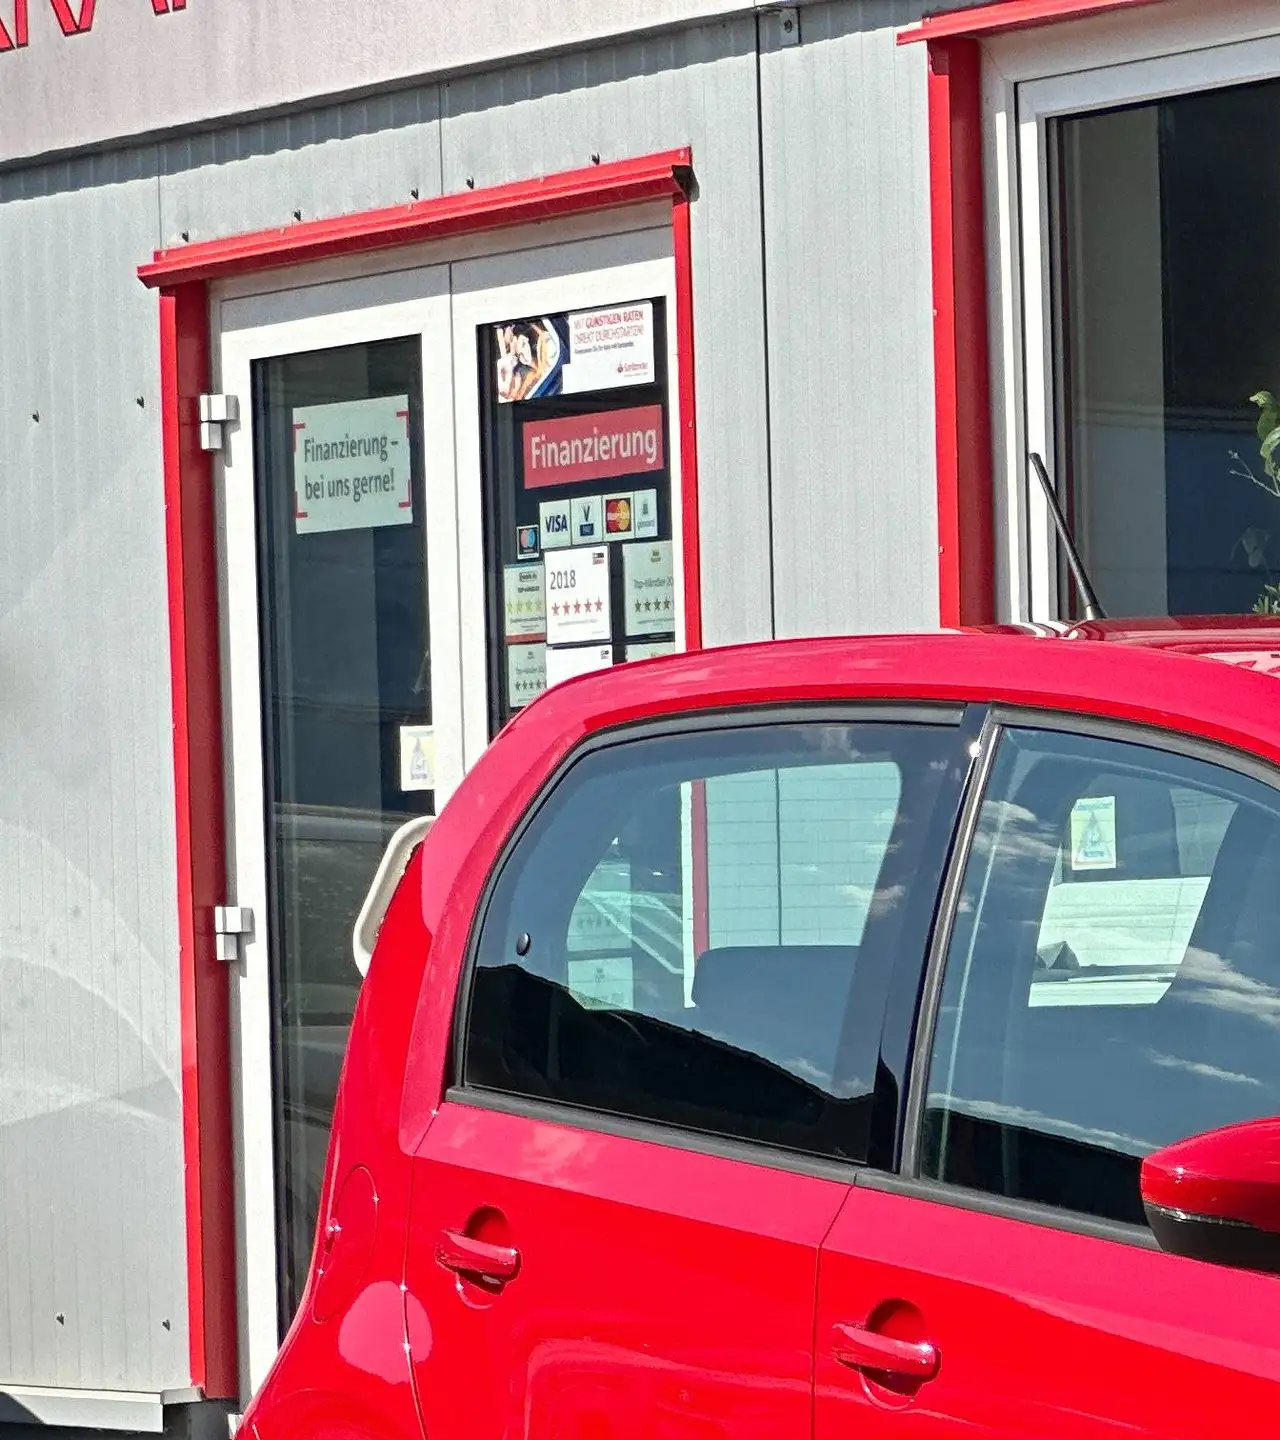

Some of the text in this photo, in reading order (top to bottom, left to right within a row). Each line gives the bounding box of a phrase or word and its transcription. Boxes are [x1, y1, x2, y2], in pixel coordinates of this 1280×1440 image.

[304, 432, 388, 463] Finanzierung
[531, 426, 657, 470] Finanzierung
[304, 467, 395, 502] bei uns gerne!
[545, 514, 568, 533] VISA
[550, 569, 576, 590] 2018
